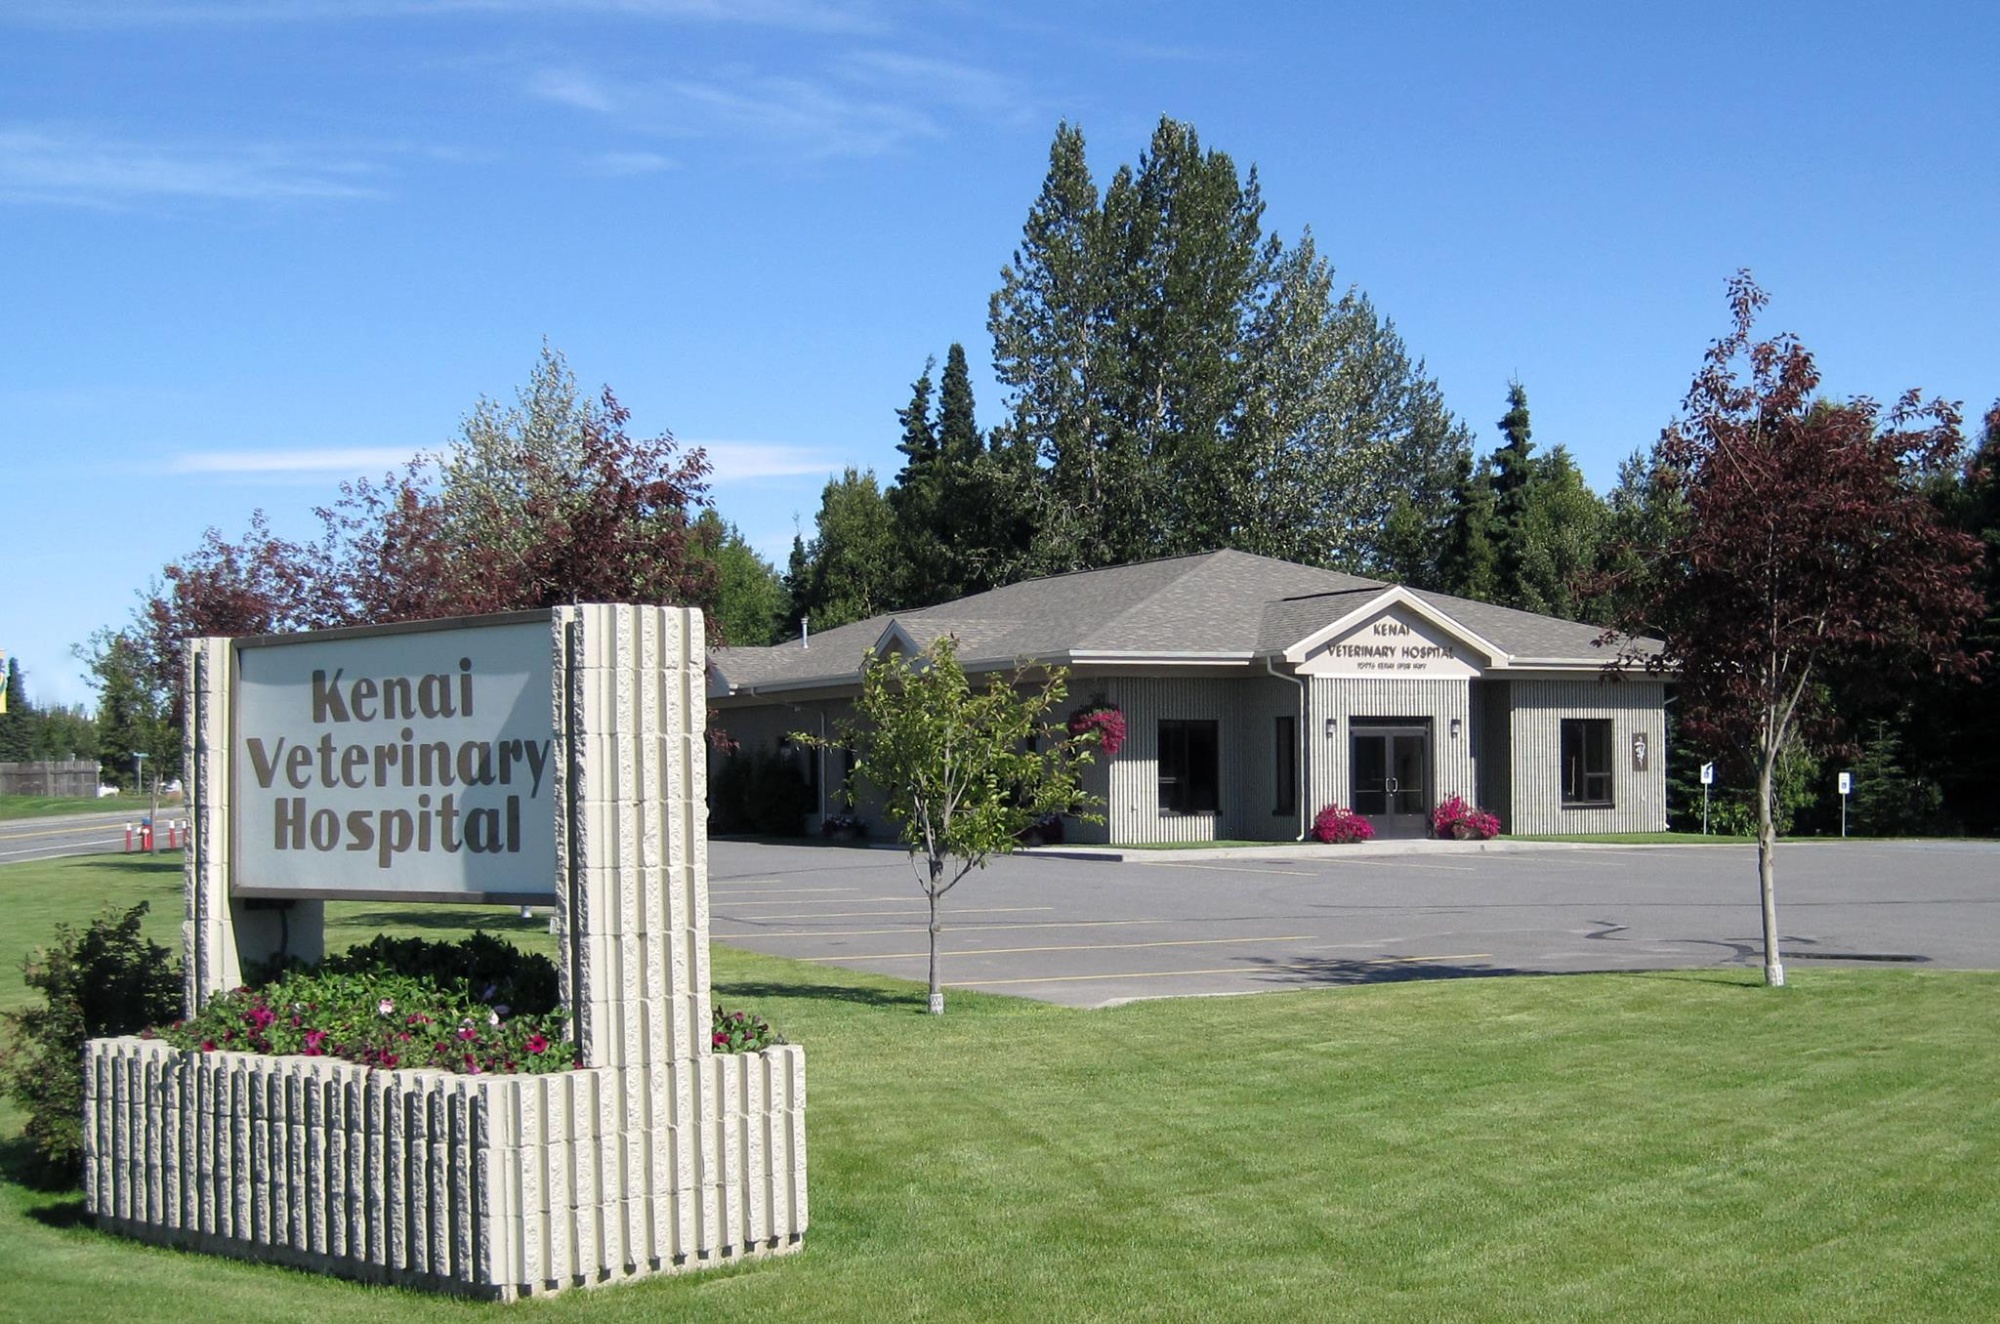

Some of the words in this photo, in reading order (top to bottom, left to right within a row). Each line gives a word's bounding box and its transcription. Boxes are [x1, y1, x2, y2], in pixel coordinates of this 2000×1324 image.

[1328, 644, 1396, 658] VETERINARY
[1402, 645, 1454, 659] HOSPITAL
[1373, 624, 1410, 636] KENAI
[312, 657, 474, 723] Kenai
[246, 727, 551, 799] Veterinary
[274, 793, 521, 868] Hospital
